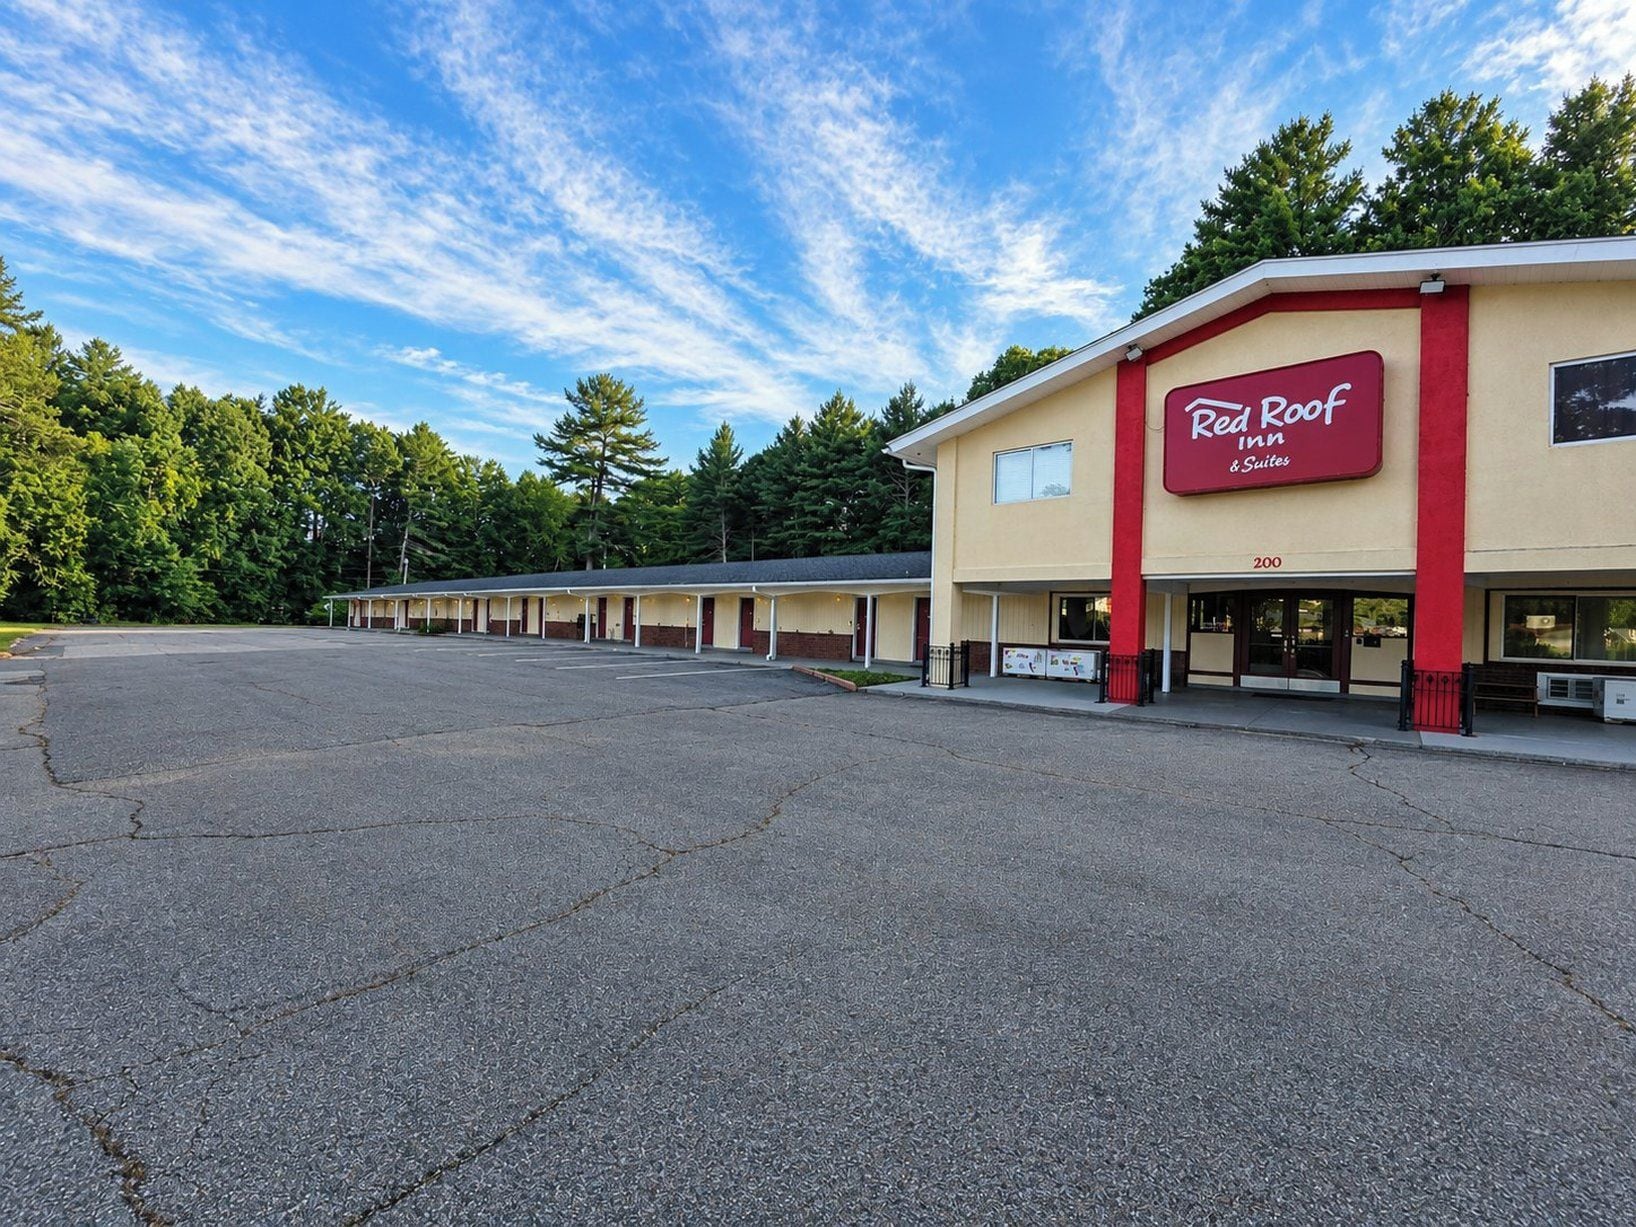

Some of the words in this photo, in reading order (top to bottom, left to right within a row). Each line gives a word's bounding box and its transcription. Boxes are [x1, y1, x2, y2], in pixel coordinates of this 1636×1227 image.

[1191, 407, 1251, 440] Red
[1261, 382, 1352, 430] Roof
[1229, 459, 1240, 473] &
[1241, 454, 1291, 473] Suites
[1253, 556, 1282, 569] 200
